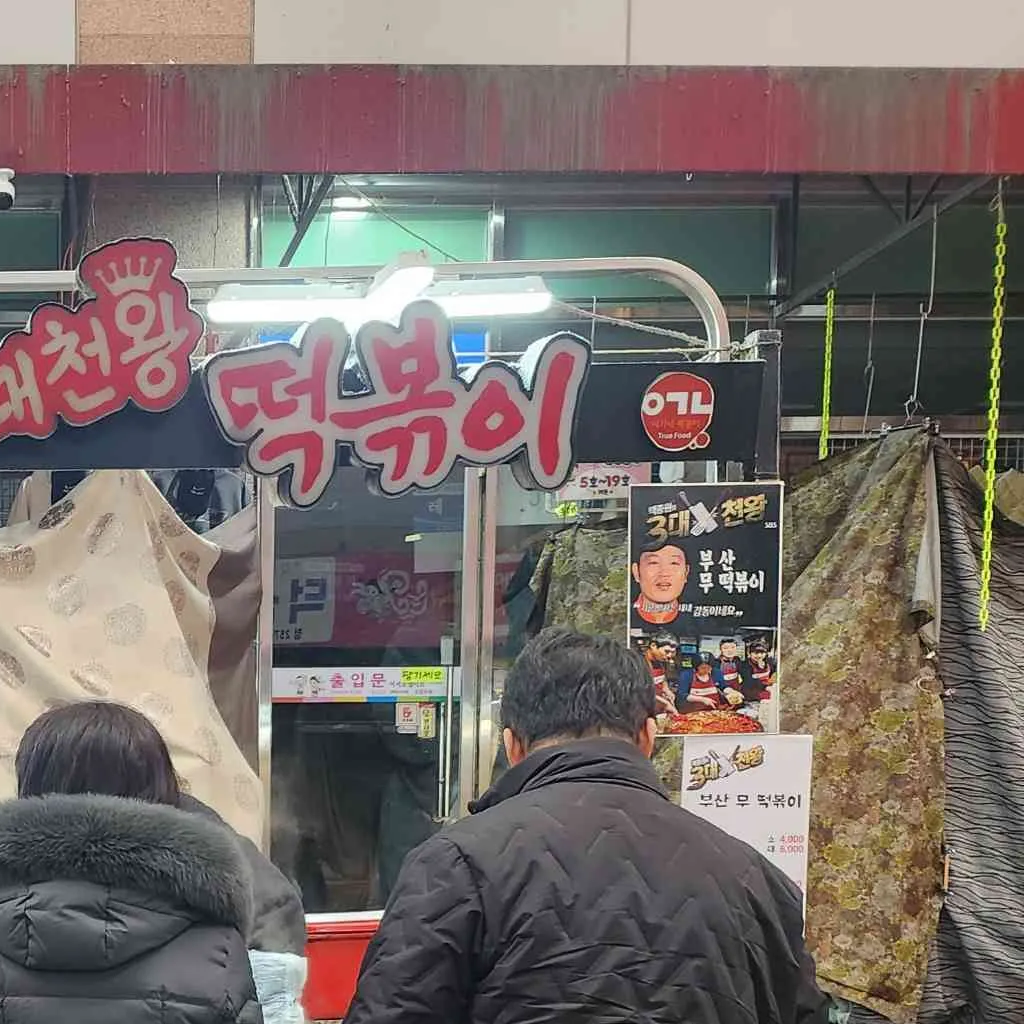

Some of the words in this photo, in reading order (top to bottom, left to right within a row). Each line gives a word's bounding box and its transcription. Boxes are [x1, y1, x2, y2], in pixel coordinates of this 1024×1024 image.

[210, 305, 588, 504] 떡볶이
[719, 493, 767, 528] 천왕
[698, 571, 714, 594] 무
[718, 569, 765, 594] 떡볶이
[330, 672, 387, 688] 출입문
[699, 793, 730, 808] 부산
[735, 794, 751, 808] 무
[757, 793, 801, 808] 떡볶이
